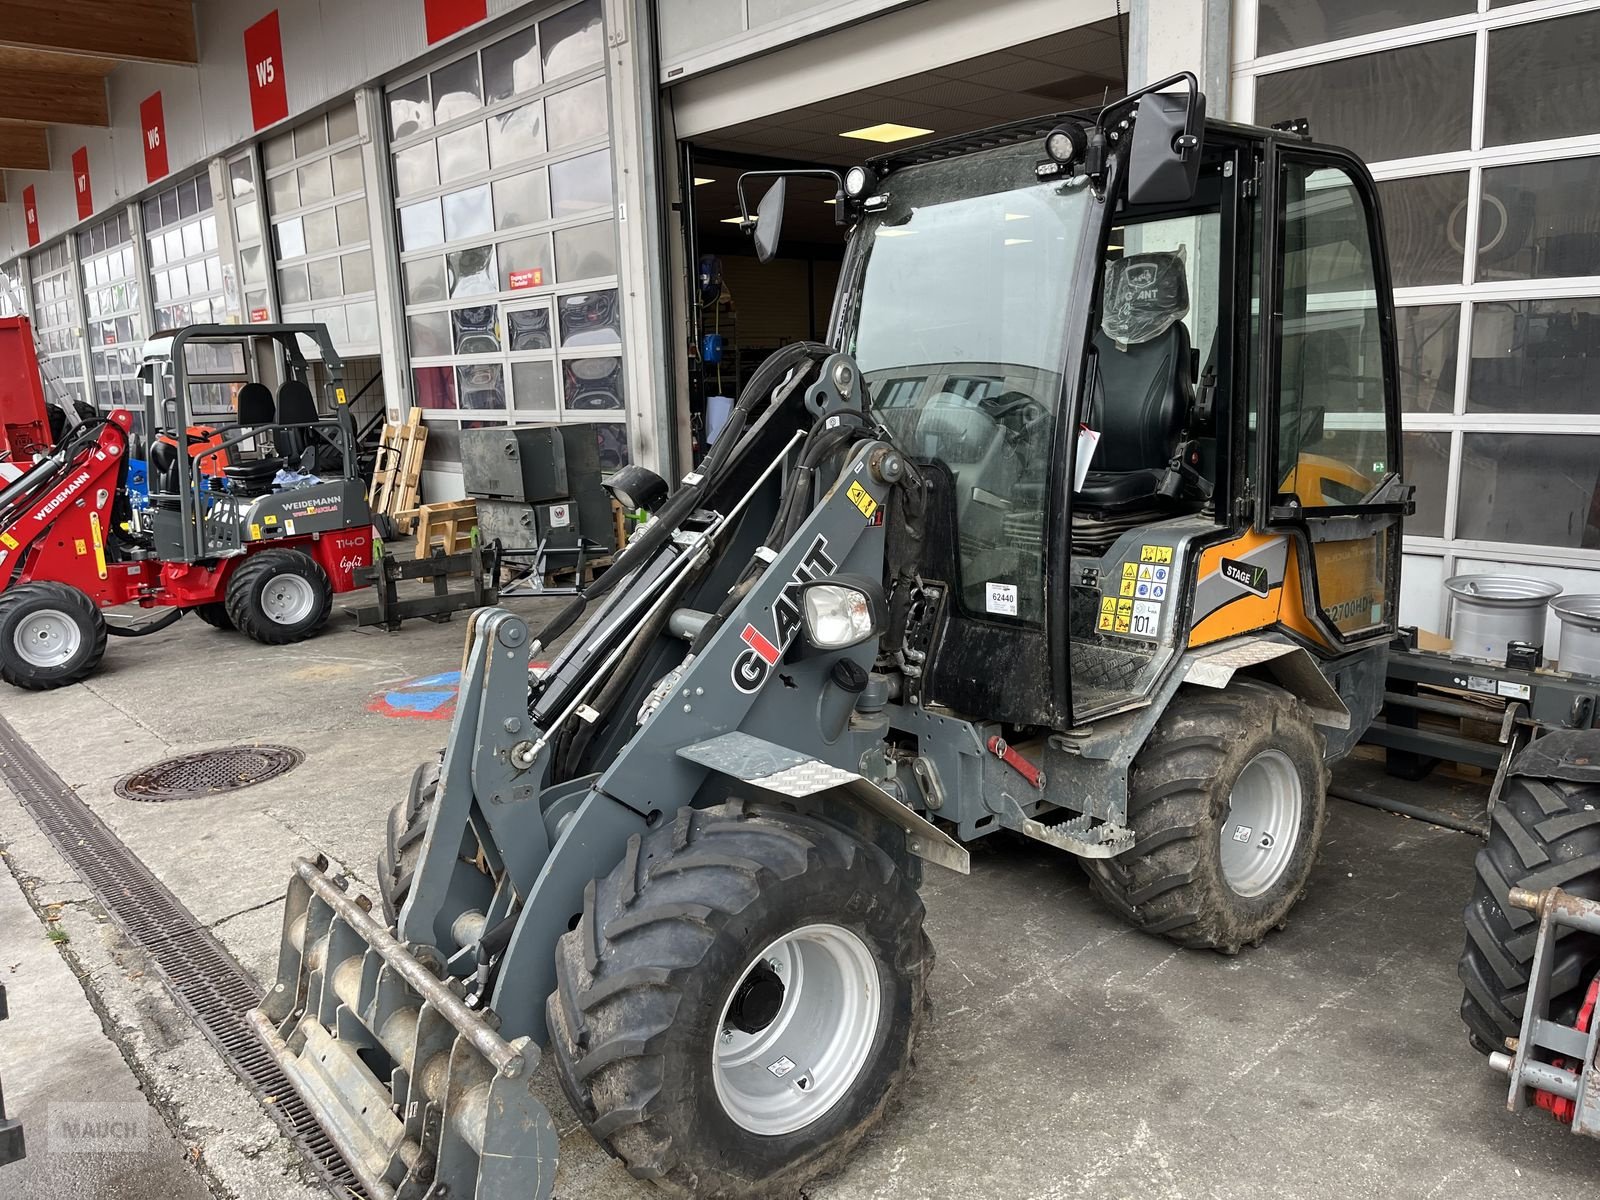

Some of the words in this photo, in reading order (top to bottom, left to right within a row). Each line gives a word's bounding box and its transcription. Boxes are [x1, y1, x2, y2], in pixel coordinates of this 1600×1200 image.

[256, 56, 275, 88] W5
[147, 126, 160, 150] W6
[77, 174, 86, 193] W7
[1124, 289, 1159, 301] GANT
[33, 472, 91, 521] WEIDEMANN
[282, 495, 341, 511] WEIDEMANN
[336, 536, 366, 549] 1140
[339, 554, 363, 574] light
[1226, 565, 1251, 584] STAGE
[1253, 566, 1267, 587] V
[992, 592, 1014, 603] 62440
[1133, 615, 1150, 634] 101
